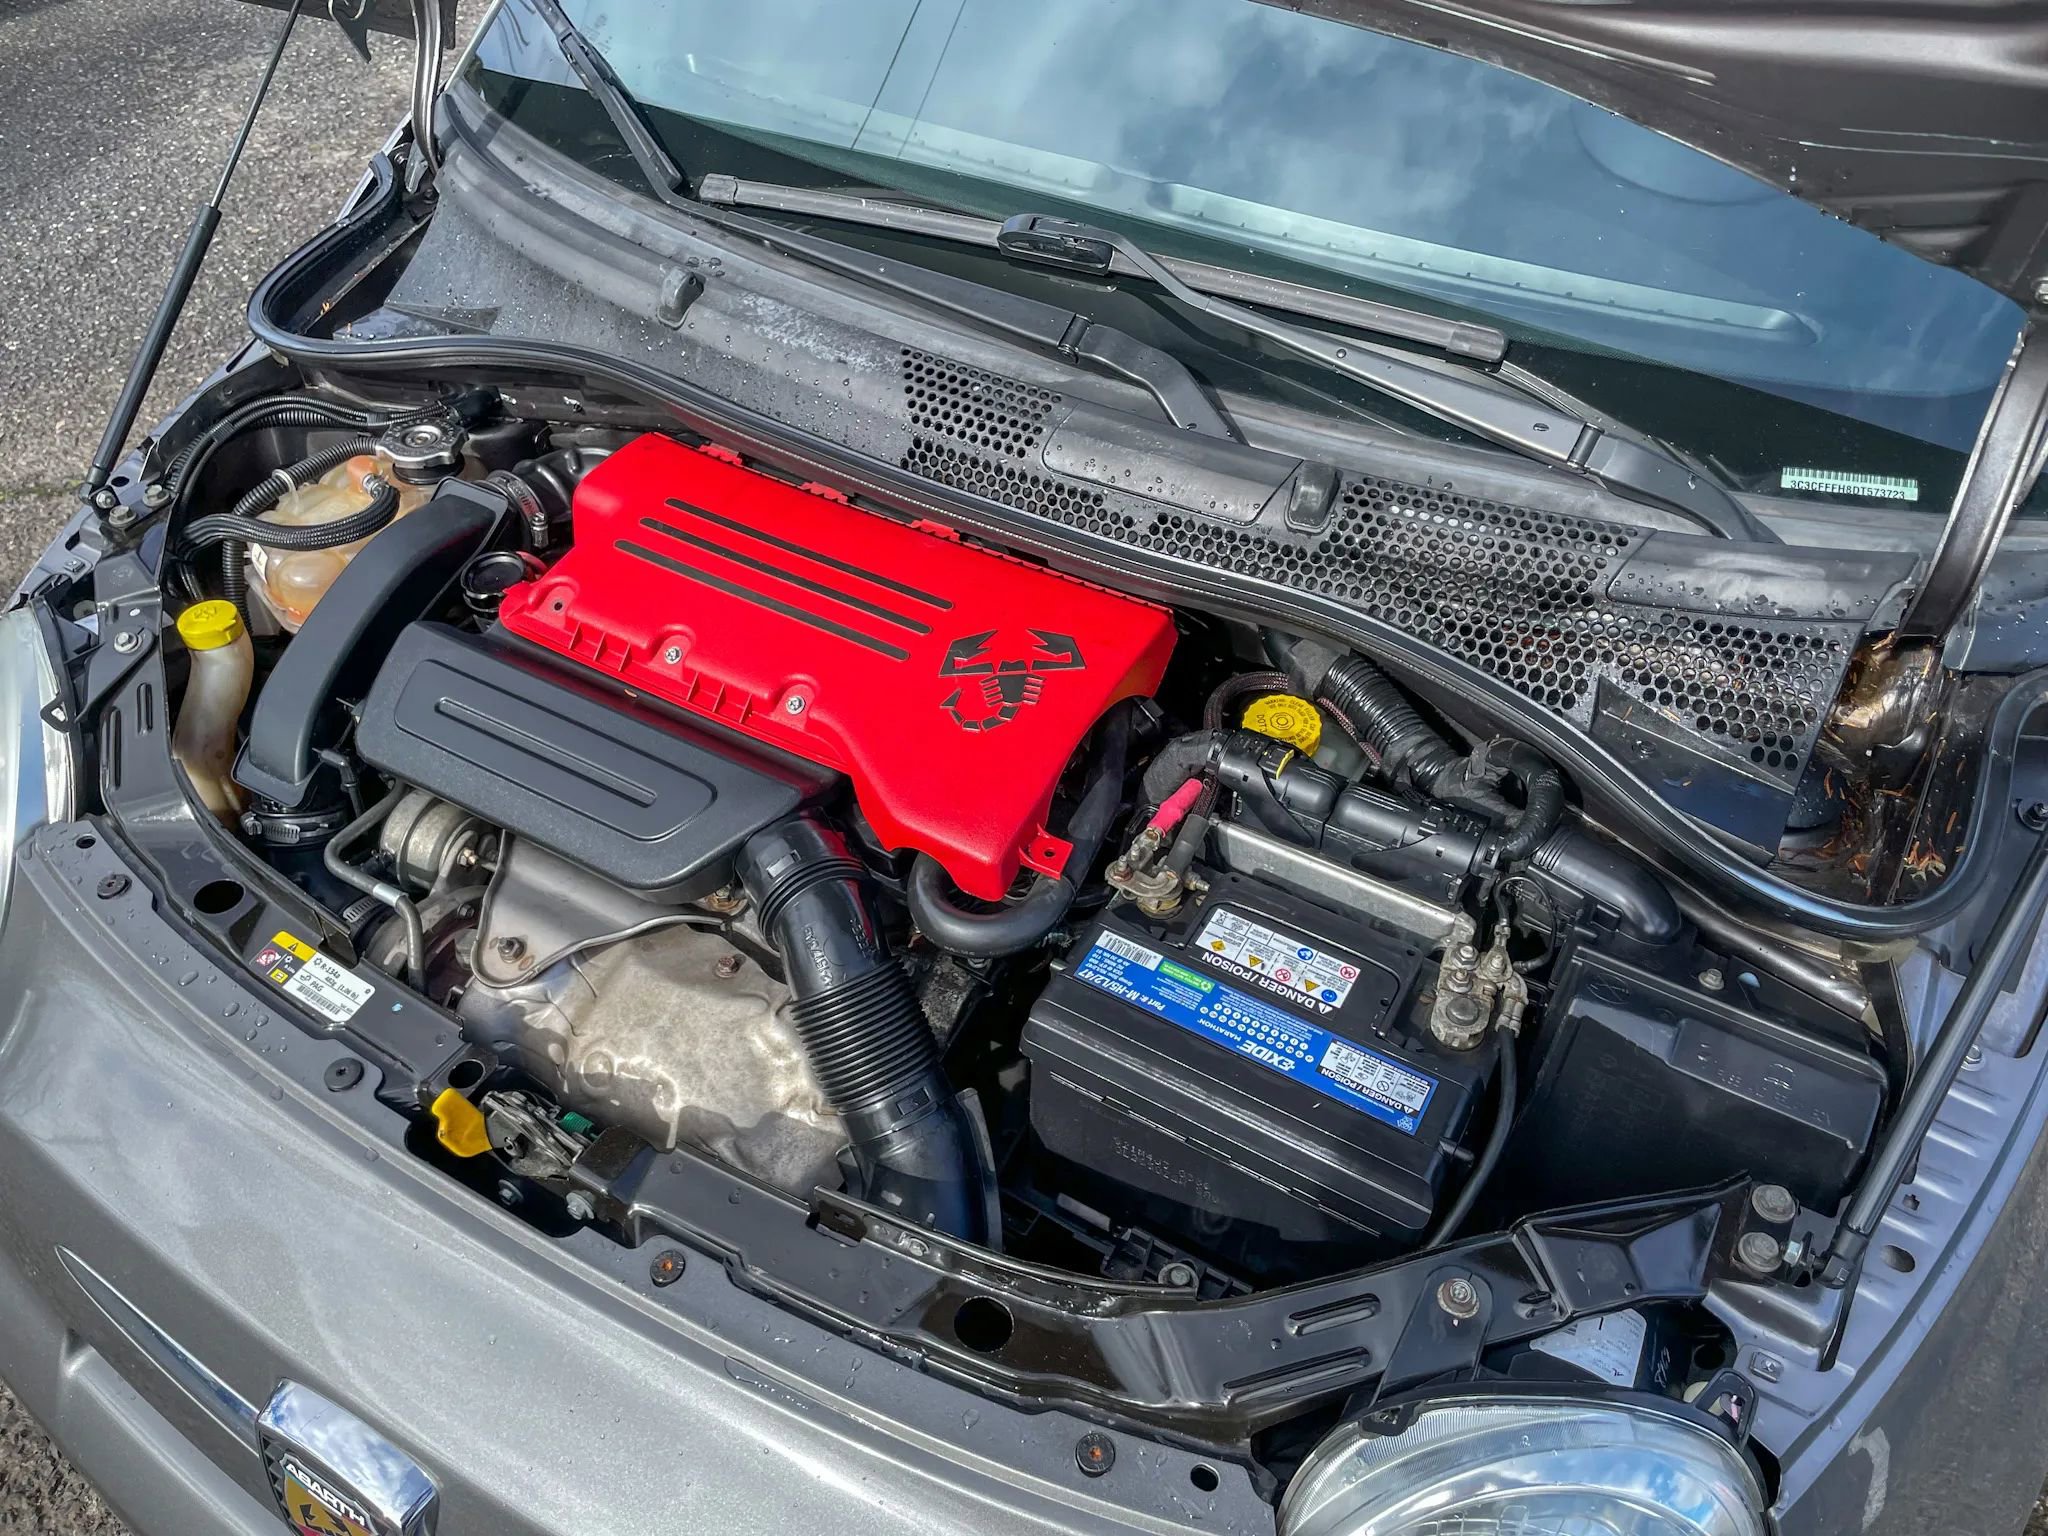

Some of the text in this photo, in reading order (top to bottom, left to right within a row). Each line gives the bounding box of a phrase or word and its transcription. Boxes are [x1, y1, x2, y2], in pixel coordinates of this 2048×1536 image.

[319, 962, 341, 979] R-134a
[1201, 950, 1252, 980] POISON
[308, 980, 324, 992] PAG
[1078, 966, 1140, 1000] M-H5/L2/47
[1258, 975, 1316, 1009] DANGER
[1147, 998, 1165, 1011] Part
[1197, 1016, 1241, 1041] MARATHON
[1238, 1038, 1296, 1072] EXIDE
[1320, 1067, 1356, 1088] POISON
[1361, 1086, 1402, 1109] DANGER
[286, 1463, 366, 1526] ABARTH
